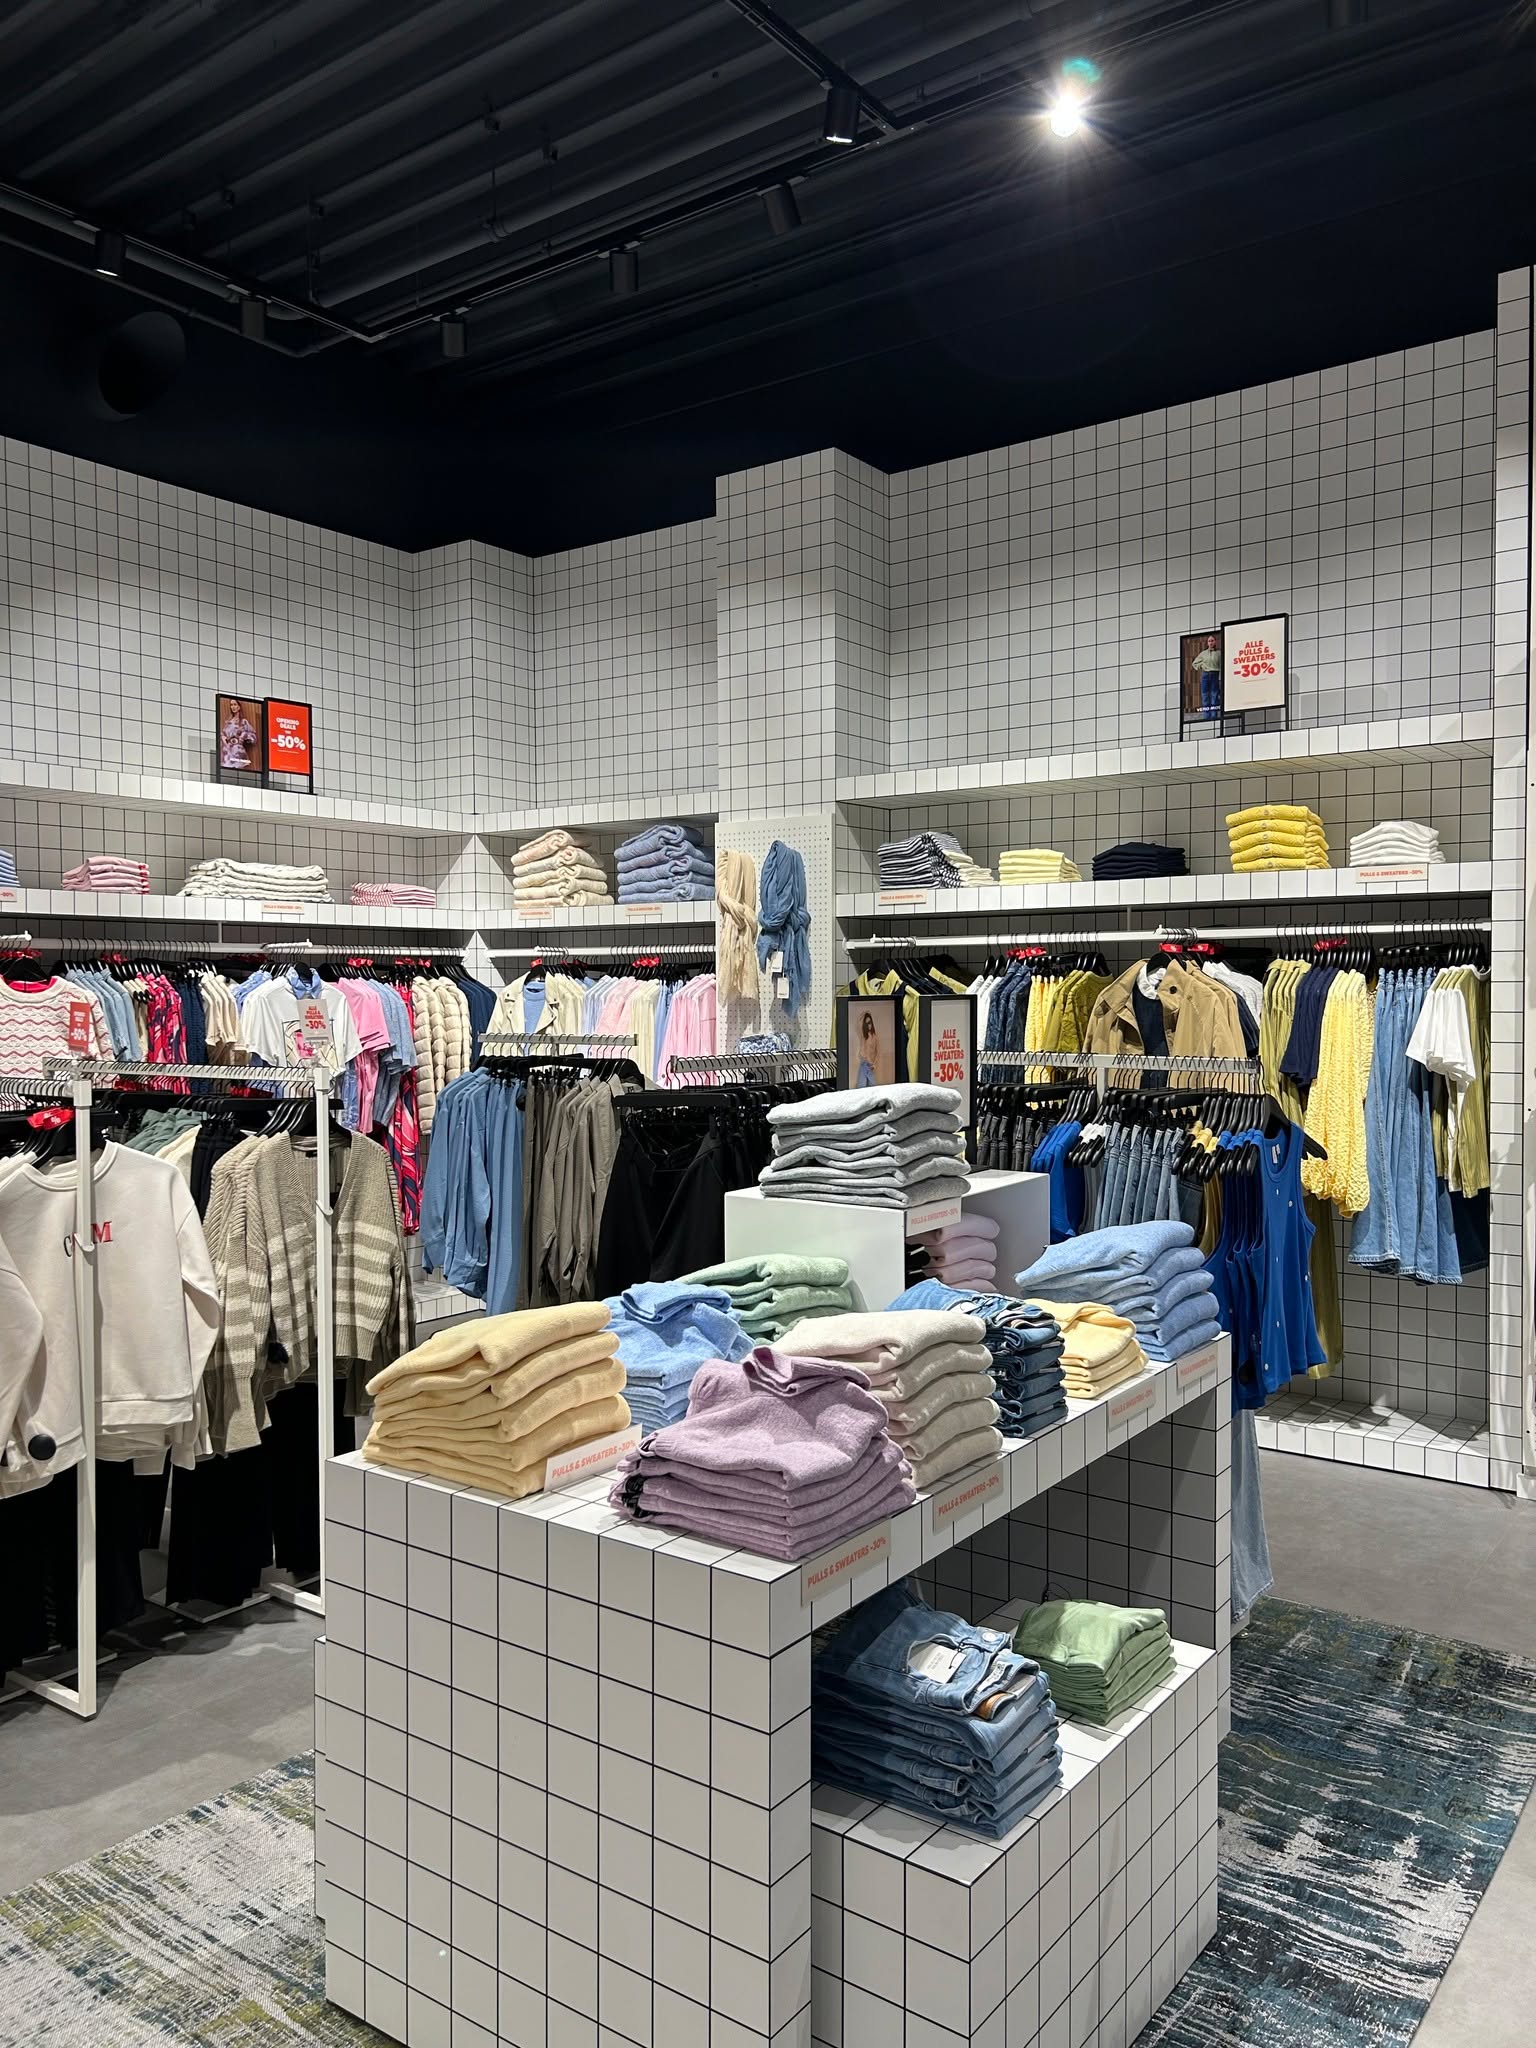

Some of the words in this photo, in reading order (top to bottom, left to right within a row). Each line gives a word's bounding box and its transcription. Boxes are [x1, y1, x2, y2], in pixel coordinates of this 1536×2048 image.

[1244, 640, 1264, 649] ALLE
[1233, 652, 1276, 665] SWEATERS
[1238, 648, 1263, 657] PULLS
[1233, 662, 1276, 677] -30%
[271, 734, 306, 751] -50%
[305, 1020, 326, 1029] -30%
[943, 1029, 956, 1039] ALLE
[938, 1040, 955, 1050] PULLS
[955, 1039, 960, 1049] &
[934, 1050, 964, 1061] SWEATERS
[934, 1062, 964, 1082] -30%
[552, 1462, 575, 1478] PULLS
[574, 1460, 580, 1470] &
[581, 1446, 618, 1467] SWEATERS
[618, 1439, 636, 1452] -30%
[938, 1499, 955, 1516] PULLS
[959, 1482, 986, 1504] SWEATERS
[807, 1567, 829, 1589] PULLS
[829, 1565, 835, 1576] &
[835, 1545, 870, 1573] SWEATERS
[870, 1536, 887, 1551] -30%
